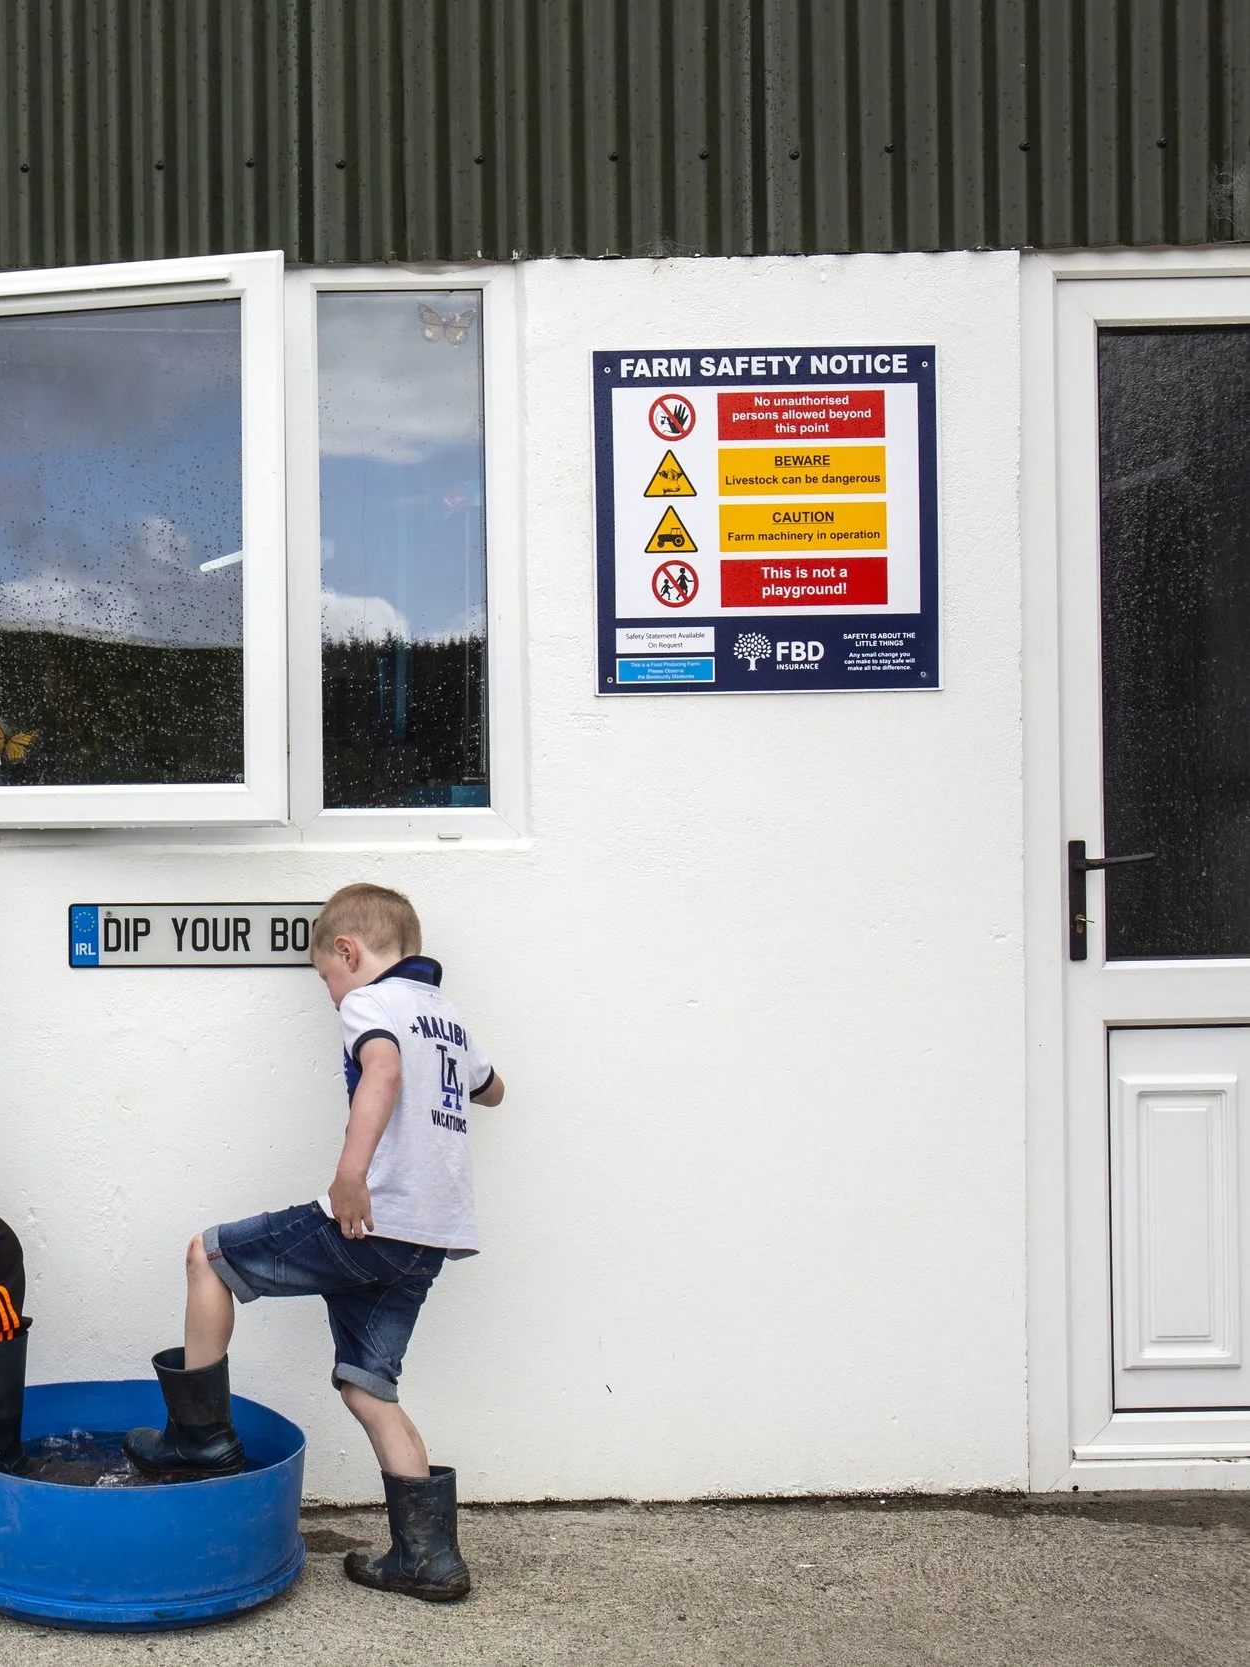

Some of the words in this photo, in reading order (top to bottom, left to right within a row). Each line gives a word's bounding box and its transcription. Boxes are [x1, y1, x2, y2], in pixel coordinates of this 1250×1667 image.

[620, 357, 691, 378] FARM
[700, 355, 801, 376] SAFETY
[810, 354, 908, 375] NOTICE
[754, 396, 771, 406] No
[774, 395, 849, 406] unauthorised
[732, 411, 779, 422] persons
[782, 409, 826, 420] allowed
[829, 408, 872, 421] beyond
[775, 423, 796, 433] this
[800, 423, 829, 434] point
[774, 455, 831, 466] BEWARE
[725, 474, 778, 486] Livestock
[781, 476, 802, 484] can
[805, 474, 819, 484] be
[822, 473, 881, 486] dangerous
[772, 511, 835, 523] CAUTION
[728, 532, 755, 541] Farm
[758, 531, 814, 542] machinery
[817, 531, 827, 540] in
[829, 530, 881, 542] operation
[761, 566, 792, 579] This
[796, 566, 808, 579] is
[813, 566, 836, 578] not
[839, 568, 848, 578] a
[762, 582, 847, 598] playground!
[776, 641, 825, 662] FBD
[103, 917, 151, 952] DIP
[171, 917, 250, 952] YOUR
[271, 917, 318, 952] BO
[75, 943, 96, 956] IRL
[431, 1109, 467, 1134] VACATIONS
